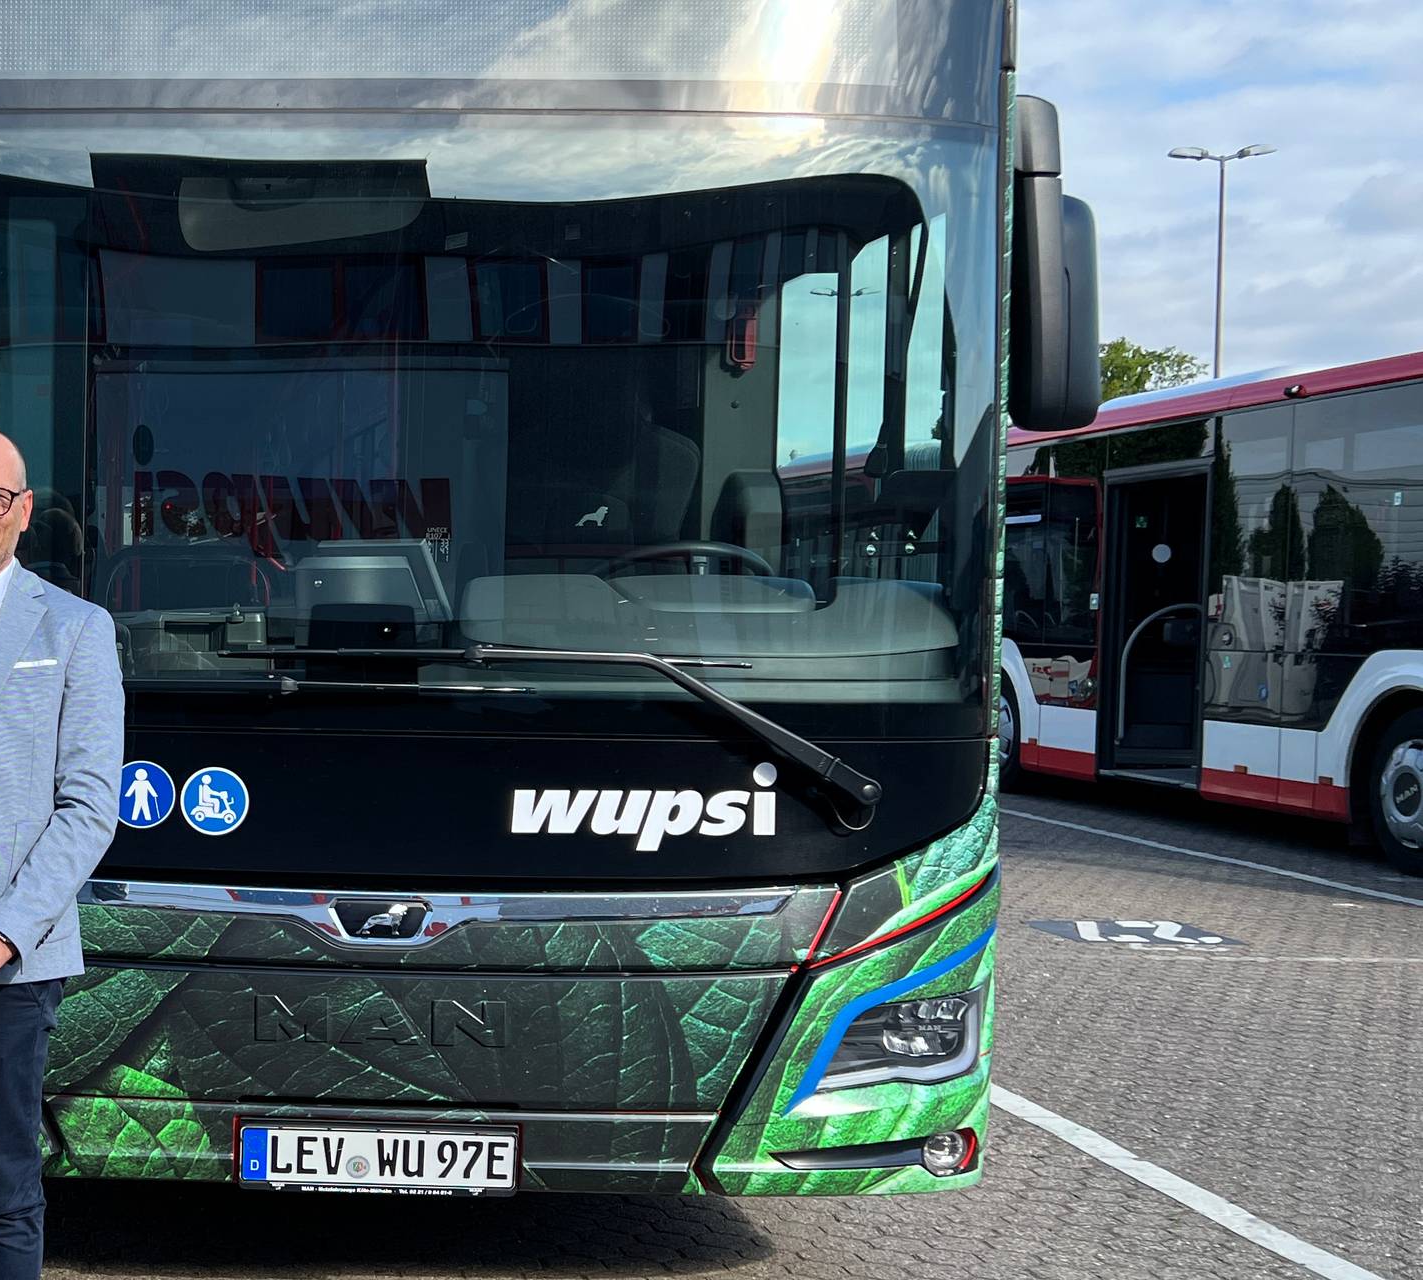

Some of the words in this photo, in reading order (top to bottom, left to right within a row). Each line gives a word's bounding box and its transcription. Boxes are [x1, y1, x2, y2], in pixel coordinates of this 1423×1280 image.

[511, 762, 777, 851] wupsi
[1396, 784, 1418, 804] MAN
[254, 994, 507, 1048] MAN
[249, 1159, 260, 1171] D
[270, 1135, 345, 1175] LEV
[376, 1139, 425, 1178] WU
[437, 1140, 509, 1180] 97E
